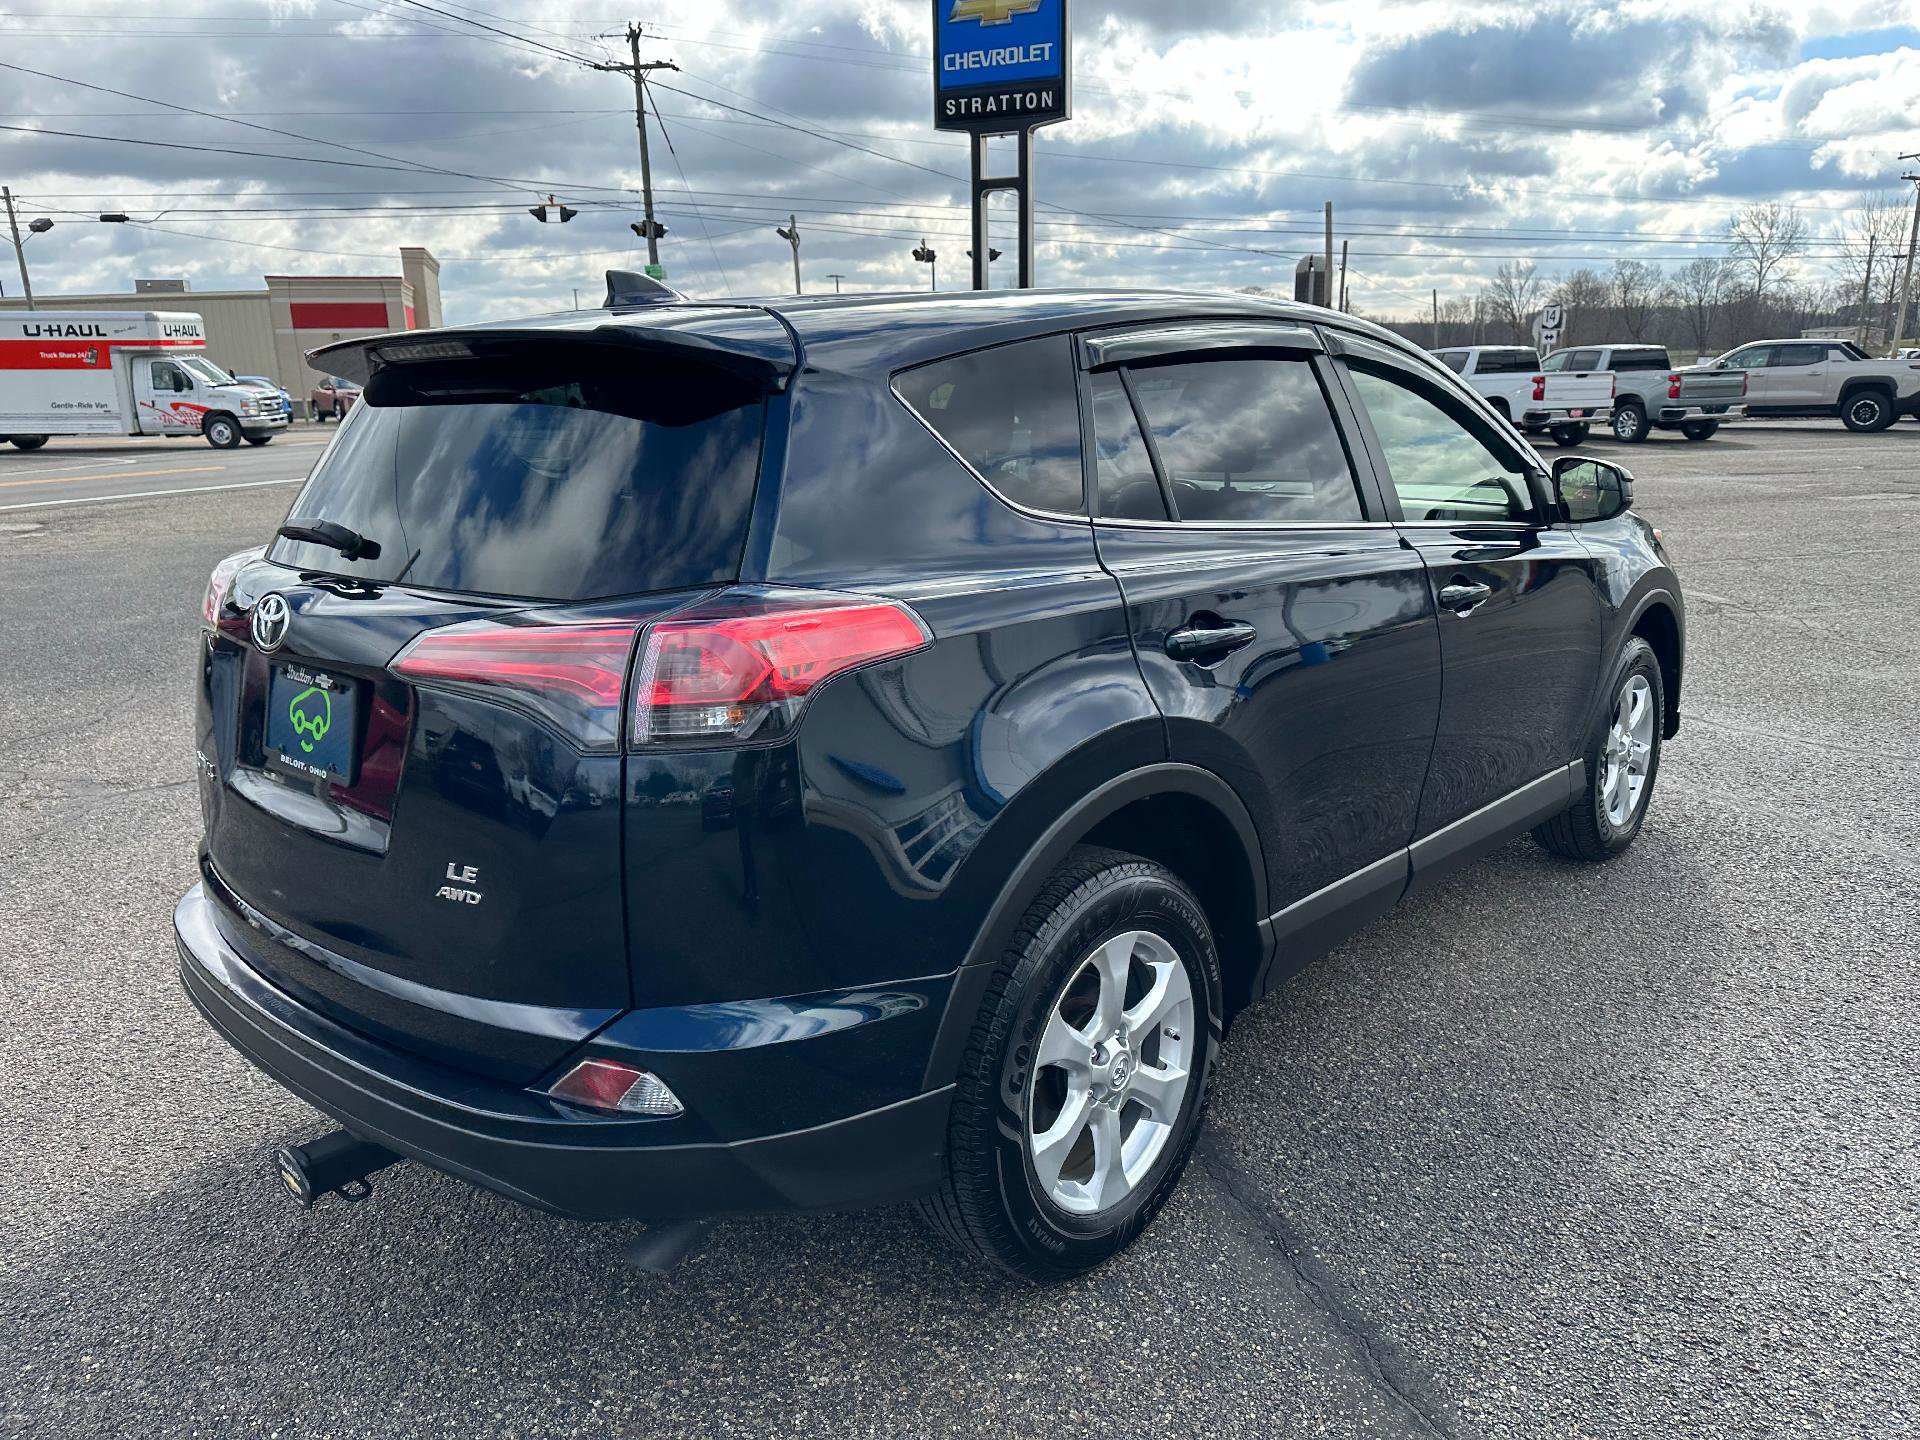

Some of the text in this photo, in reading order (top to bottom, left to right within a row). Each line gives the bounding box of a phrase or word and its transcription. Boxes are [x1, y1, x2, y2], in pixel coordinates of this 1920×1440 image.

[943, 42, 1053, 71] CHEVROLET
[945, 91, 1053, 115] STRATTON
[1545, 310, 1556, 323] 14
[23, 324, 107, 337] U-HAUL
[163, 324, 200, 337] U-HAUL
[40, 351, 57, 359] Truck
[58, 351, 77, 359] Share
[94, 401, 108, 409] Van
[309, 765, 327, 779] OHIO
[446, 862, 479, 884] LE
[435, 886, 482, 905] AWD
